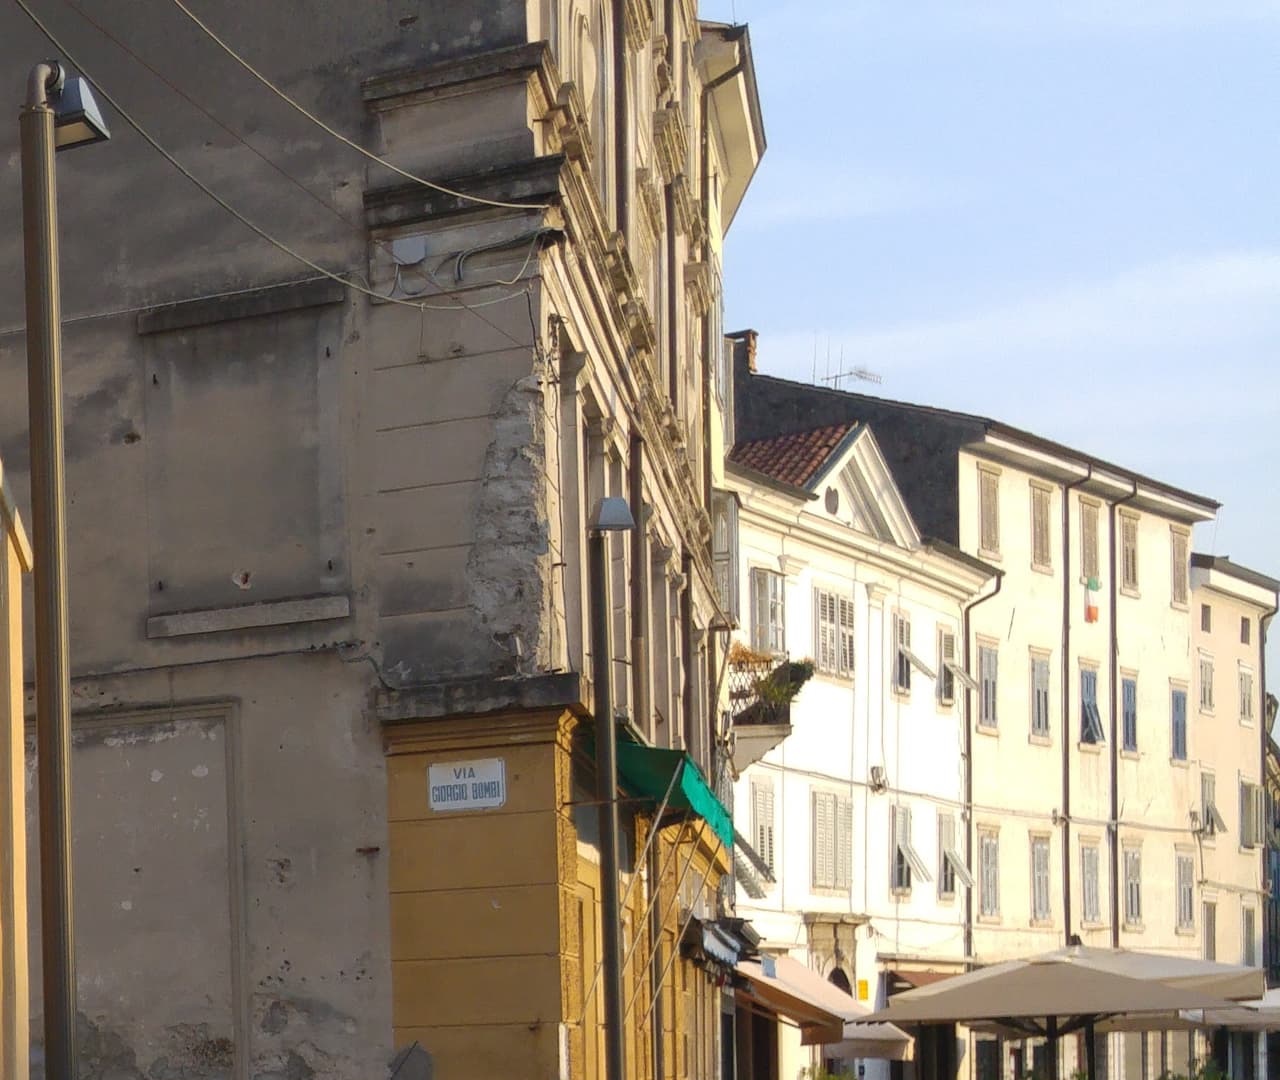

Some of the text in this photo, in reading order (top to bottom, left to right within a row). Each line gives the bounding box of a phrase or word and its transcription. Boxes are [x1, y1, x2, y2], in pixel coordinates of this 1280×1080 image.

[453, 767, 476, 779] VIA
[432, 780, 500, 803] GIORGIO BOMBI
